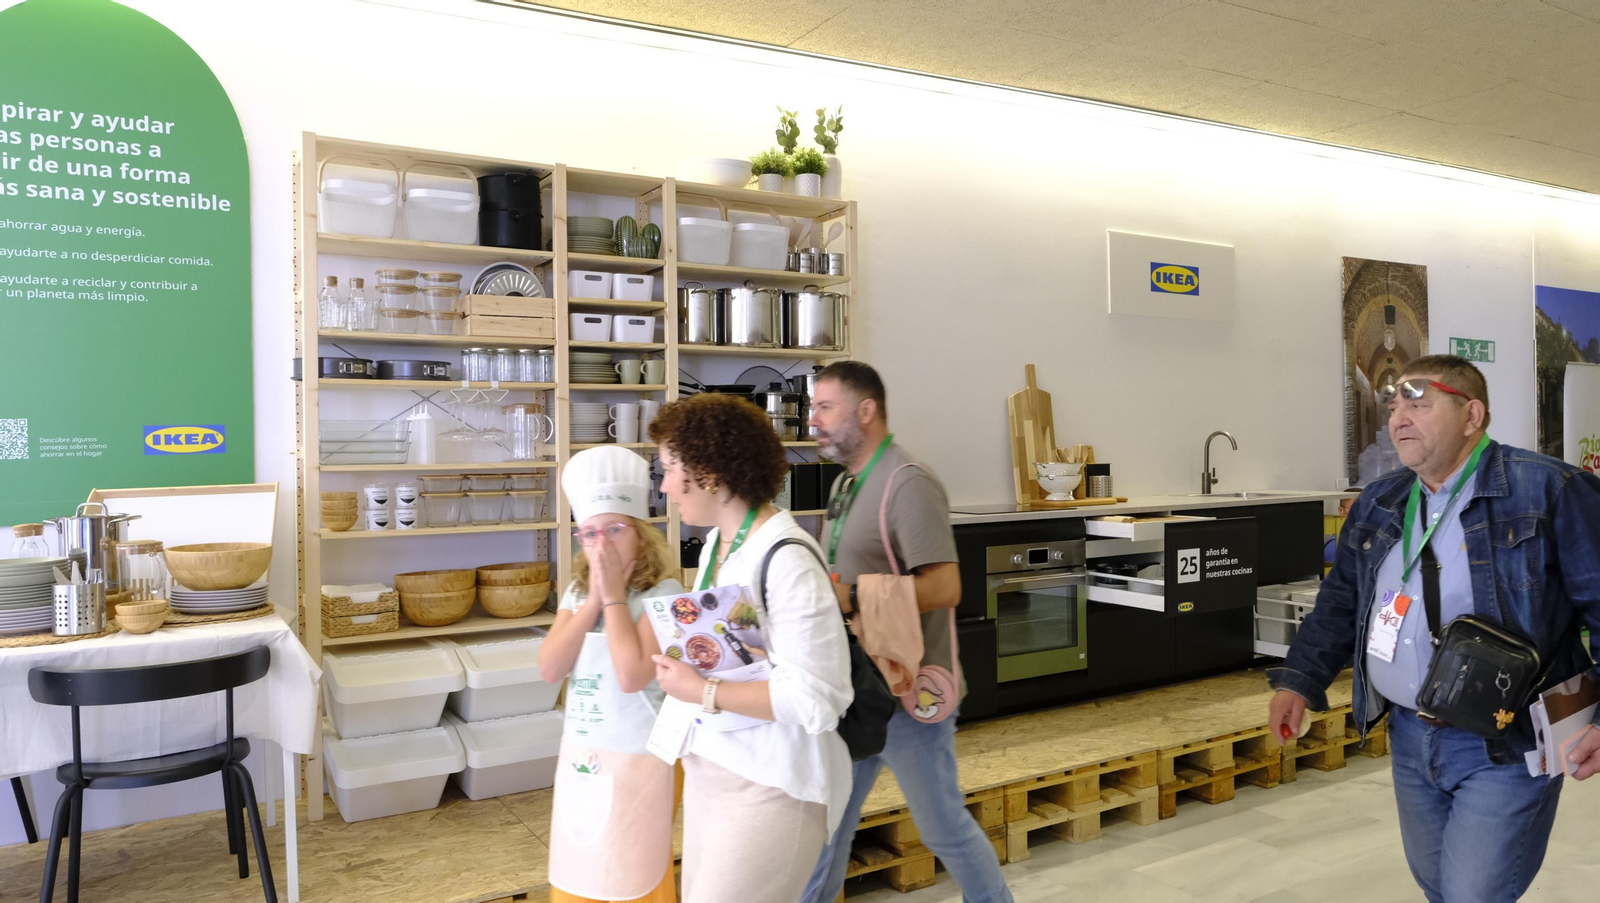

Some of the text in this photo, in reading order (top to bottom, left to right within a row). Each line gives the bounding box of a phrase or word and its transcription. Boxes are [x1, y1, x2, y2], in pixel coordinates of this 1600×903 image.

[2, 102, 174, 134] pirar y ayudar
[31, 132, 141, 156] personas
[149, 145, 161, 157] a
[0, 152, 190, 184] ir de una forma
[26, 184, 84, 200] sana
[92, 190, 106, 206] y
[113, 193, 230, 211] sostenible
[0, 219, 145, 238] ahorrar agua y energía.
[0, 248, 56, 258] ayudarte
[91, 251, 165, 263] desperdiciar
[169, 257, 213, 266] comida.
[0, 275, 57, 286] ayudarte
[73, 278, 116, 287] reciclar
[120, 281, 127, 290] y
[131, 281, 187, 290] contribuir
[1155, 271, 1196, 286] IKEA
[27, 289, 74, 300] planeta
[79, 291, 104, 300] más
[108, 291, 148, 303] limpio.
[152, 433, 219, 445] IKEA
[1220, 547, 1229, 555] de
[1180, 556, 1198, 575] 25
[1205, 558, 1231, 569] garantía
[1206, 567, 1253, 578] nuestras cocinas
